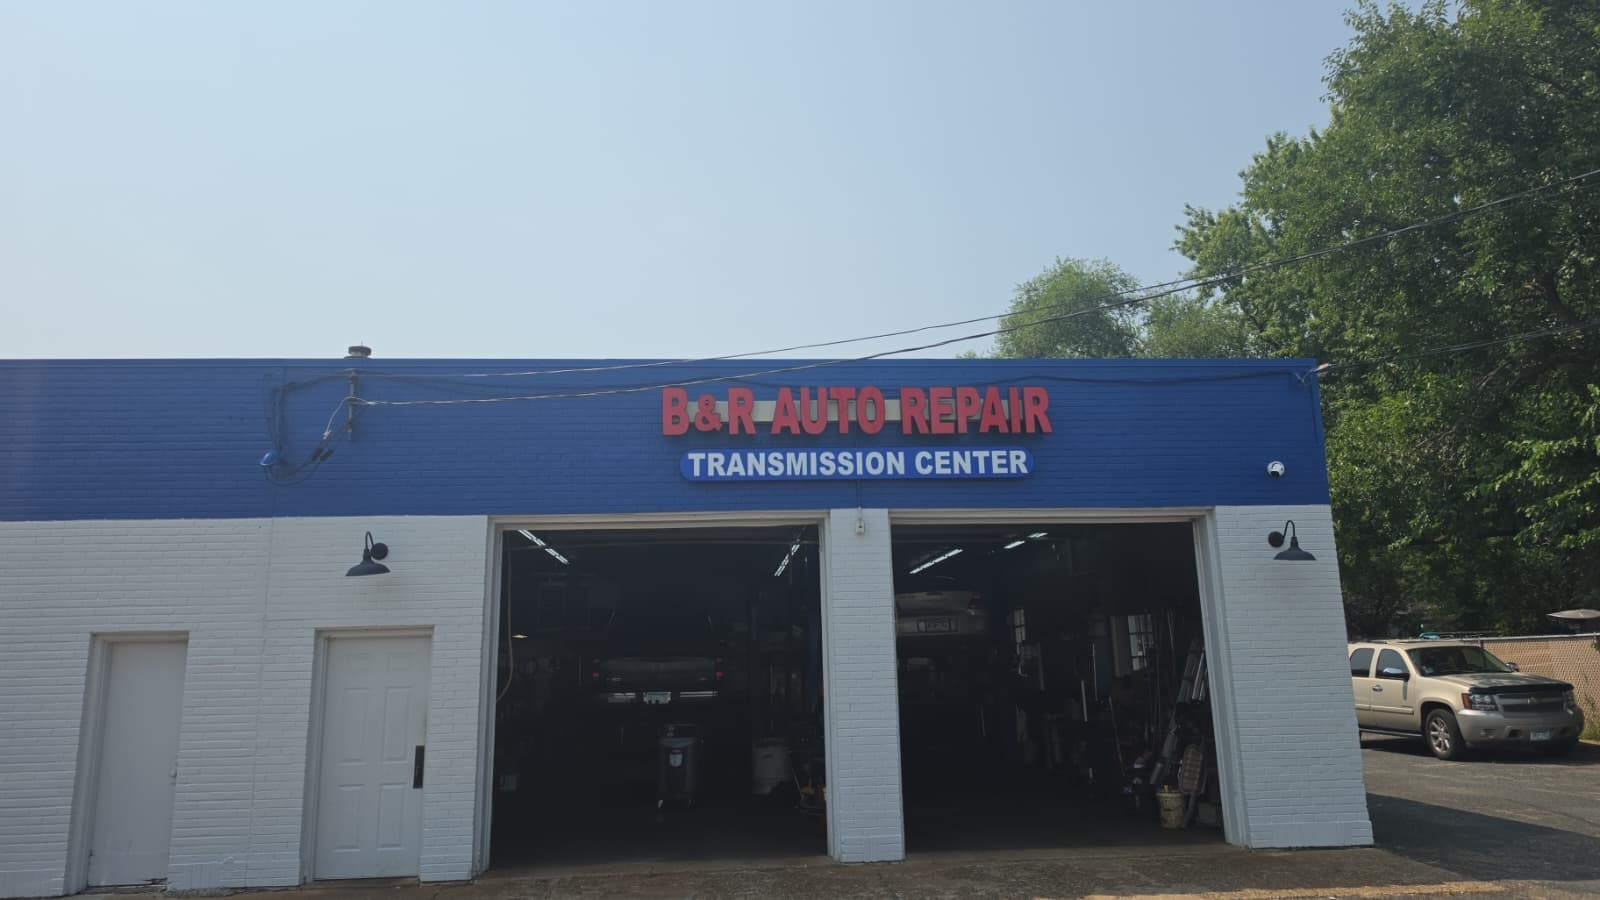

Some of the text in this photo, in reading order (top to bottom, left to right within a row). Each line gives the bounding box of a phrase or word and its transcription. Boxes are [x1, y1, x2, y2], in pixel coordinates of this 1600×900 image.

[770, 384, 887, 435] AUTO
[900, 385, 1053, 435] REPAIR
[687, 449, 1029, 478] TRANSMISSION CENTER
